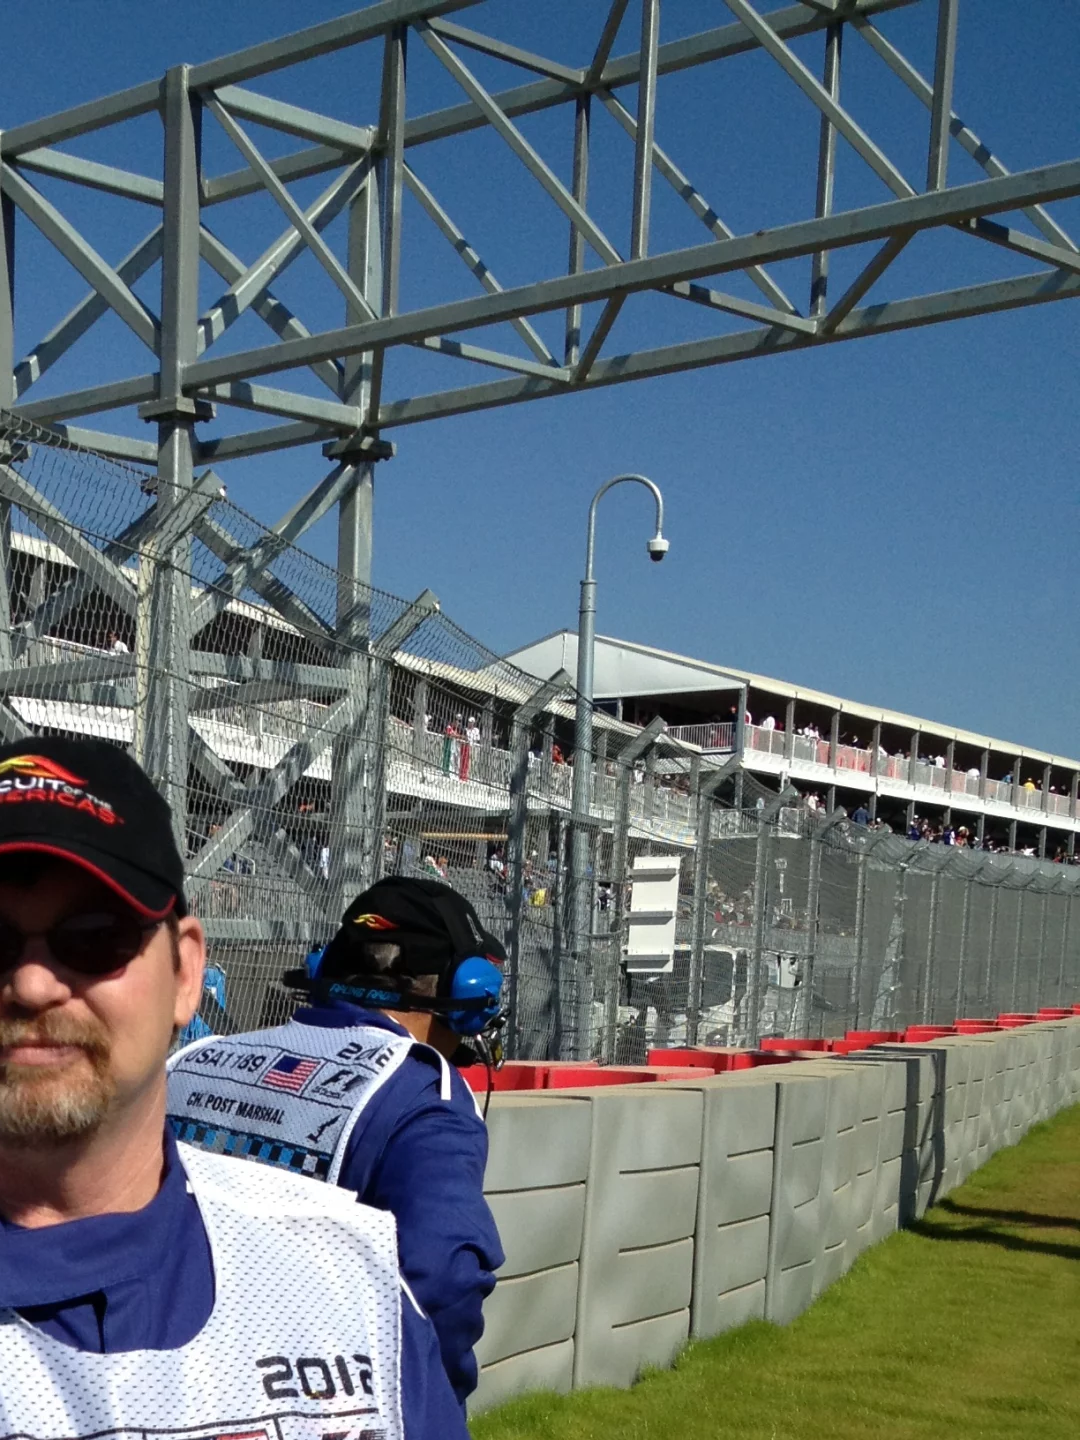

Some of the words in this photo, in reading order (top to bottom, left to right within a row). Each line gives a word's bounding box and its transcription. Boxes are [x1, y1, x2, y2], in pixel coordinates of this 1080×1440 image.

[184, 1048, 267, 1072] USA1189
[204, 1096, 237, 1113] POST
[237, 1103, 285, 1125] MARSHAL
